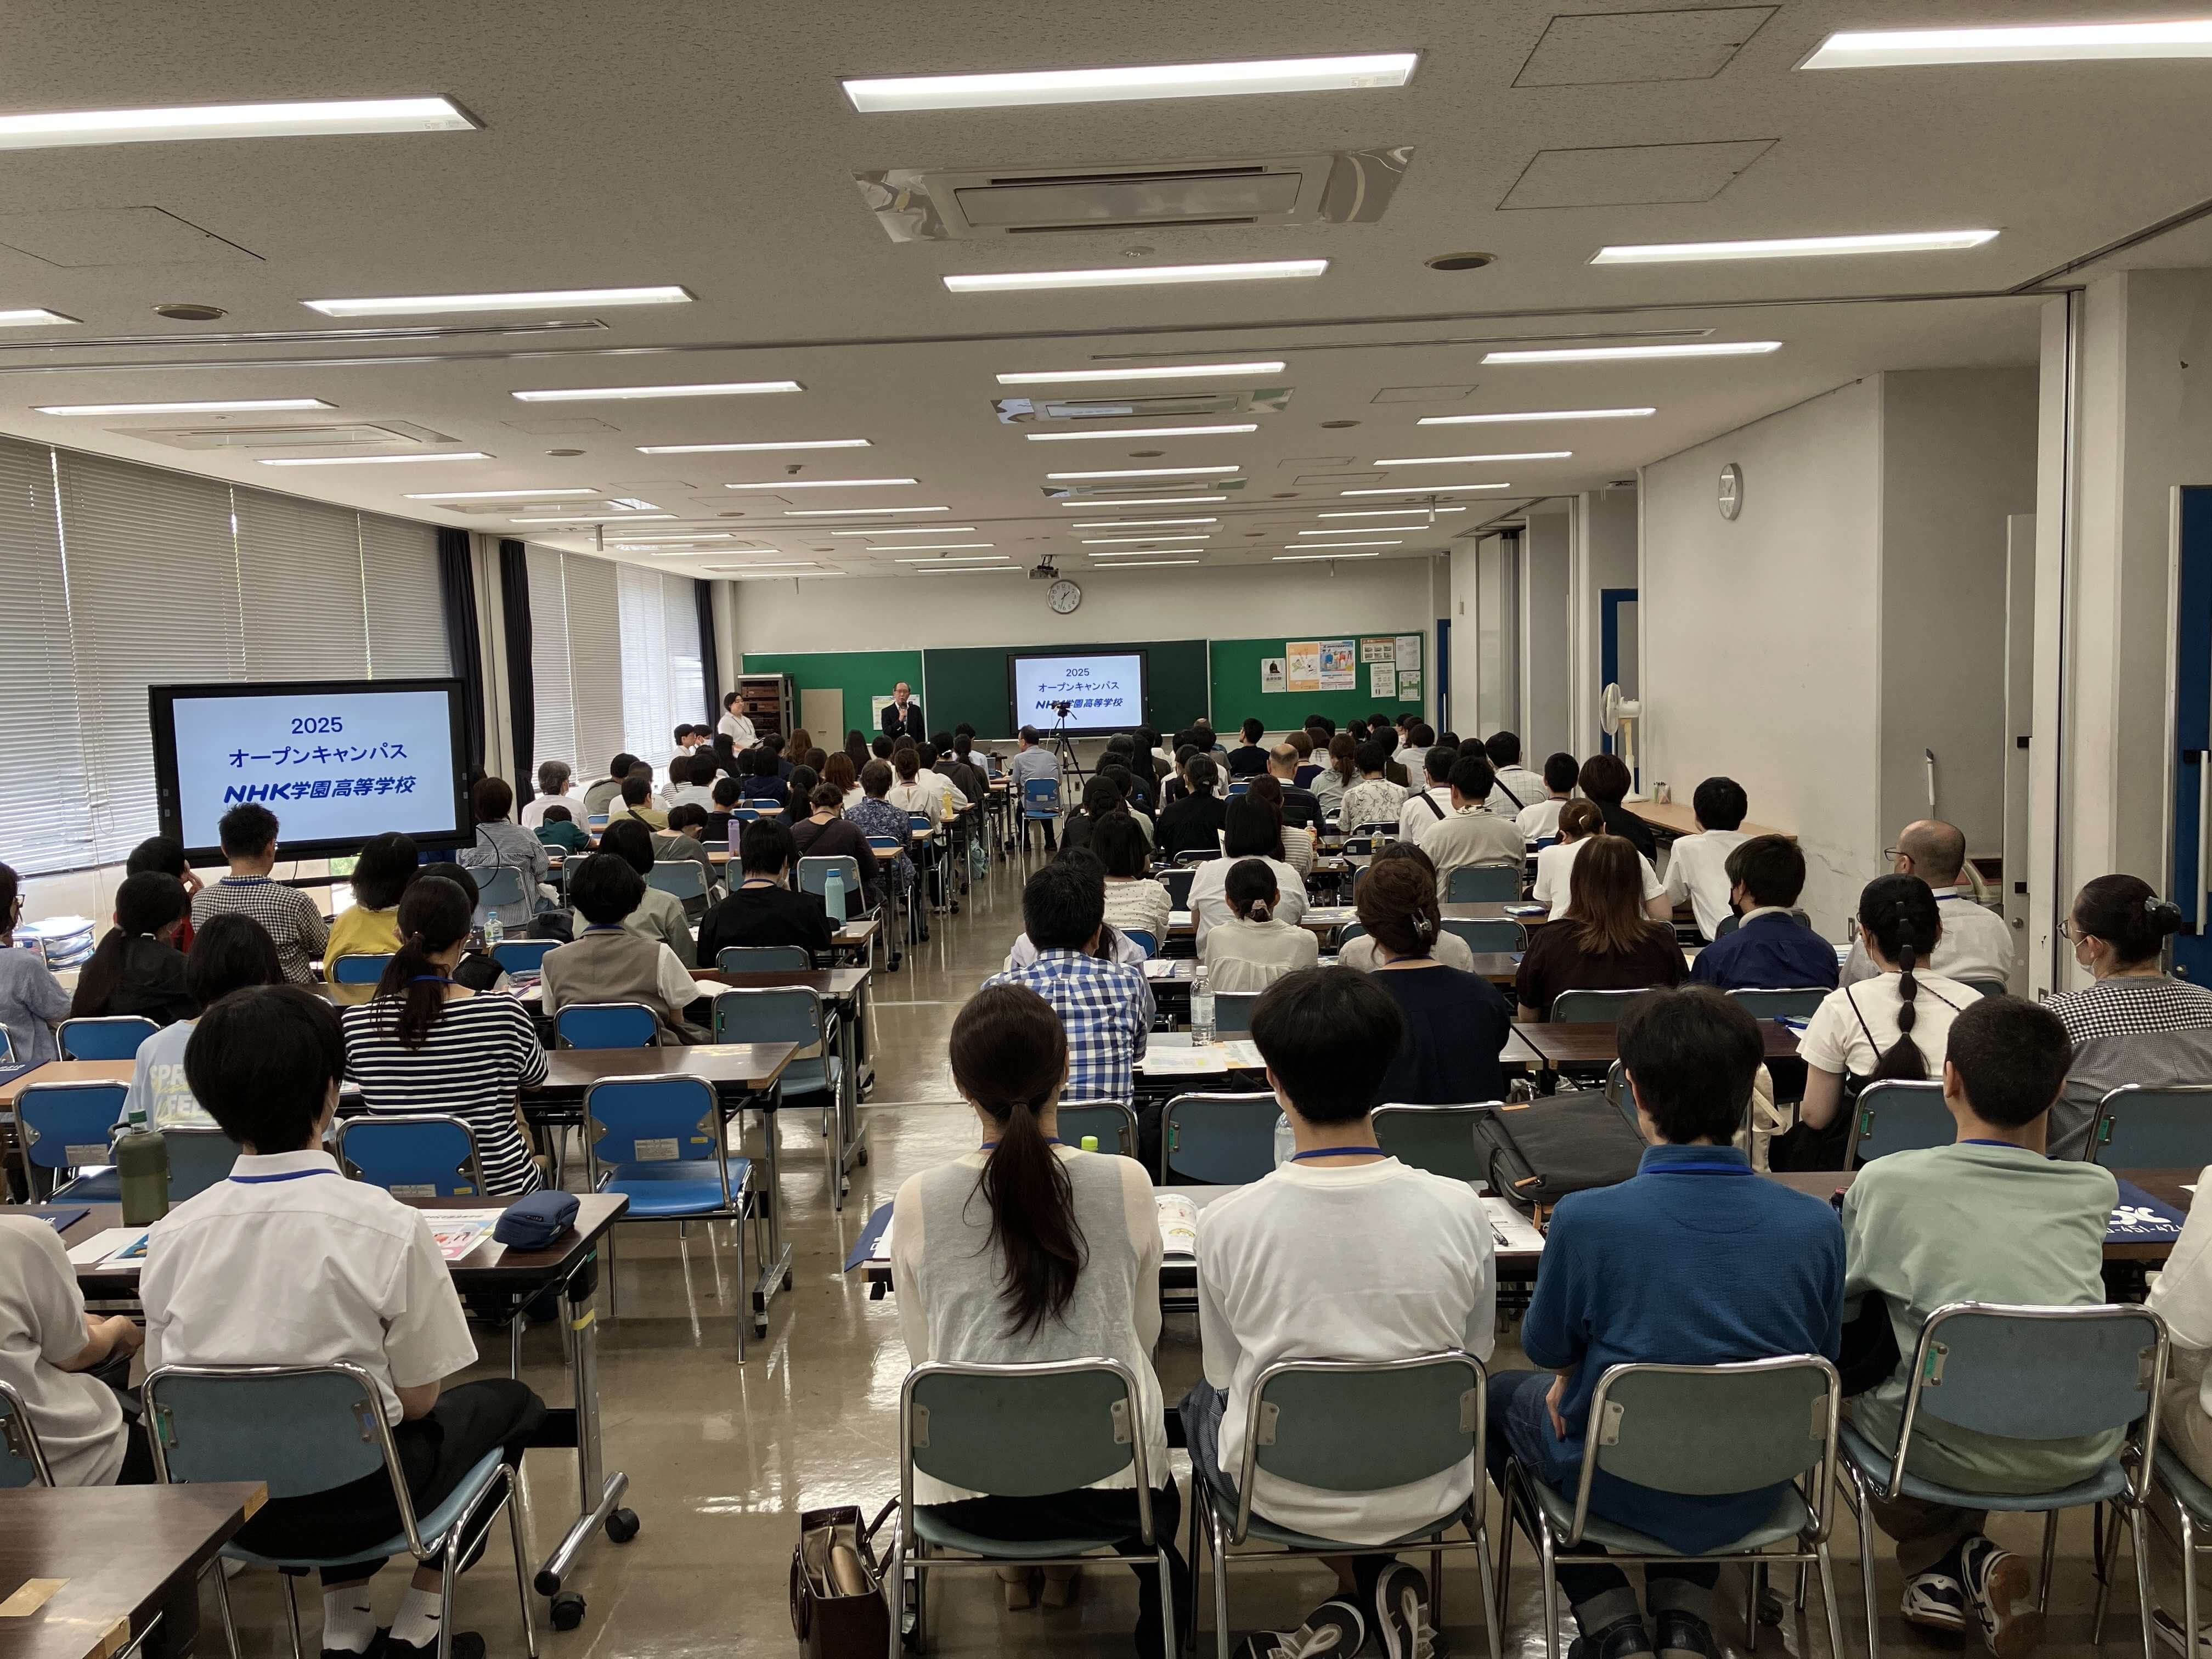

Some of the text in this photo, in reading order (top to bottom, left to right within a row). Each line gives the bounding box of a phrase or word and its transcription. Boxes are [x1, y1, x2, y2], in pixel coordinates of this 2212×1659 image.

[1066, 668, 1090, 676] 2025
[1038, 680, 1119, 692] オープンキャンパス
[1036, 697, 1123, 709] NH学園高等学校
[291, 716, 343, 734] 2025
[229, 742, 408, 768] オープンキャンパス
[224, 775, 416, 803] NHK学園高等学校
